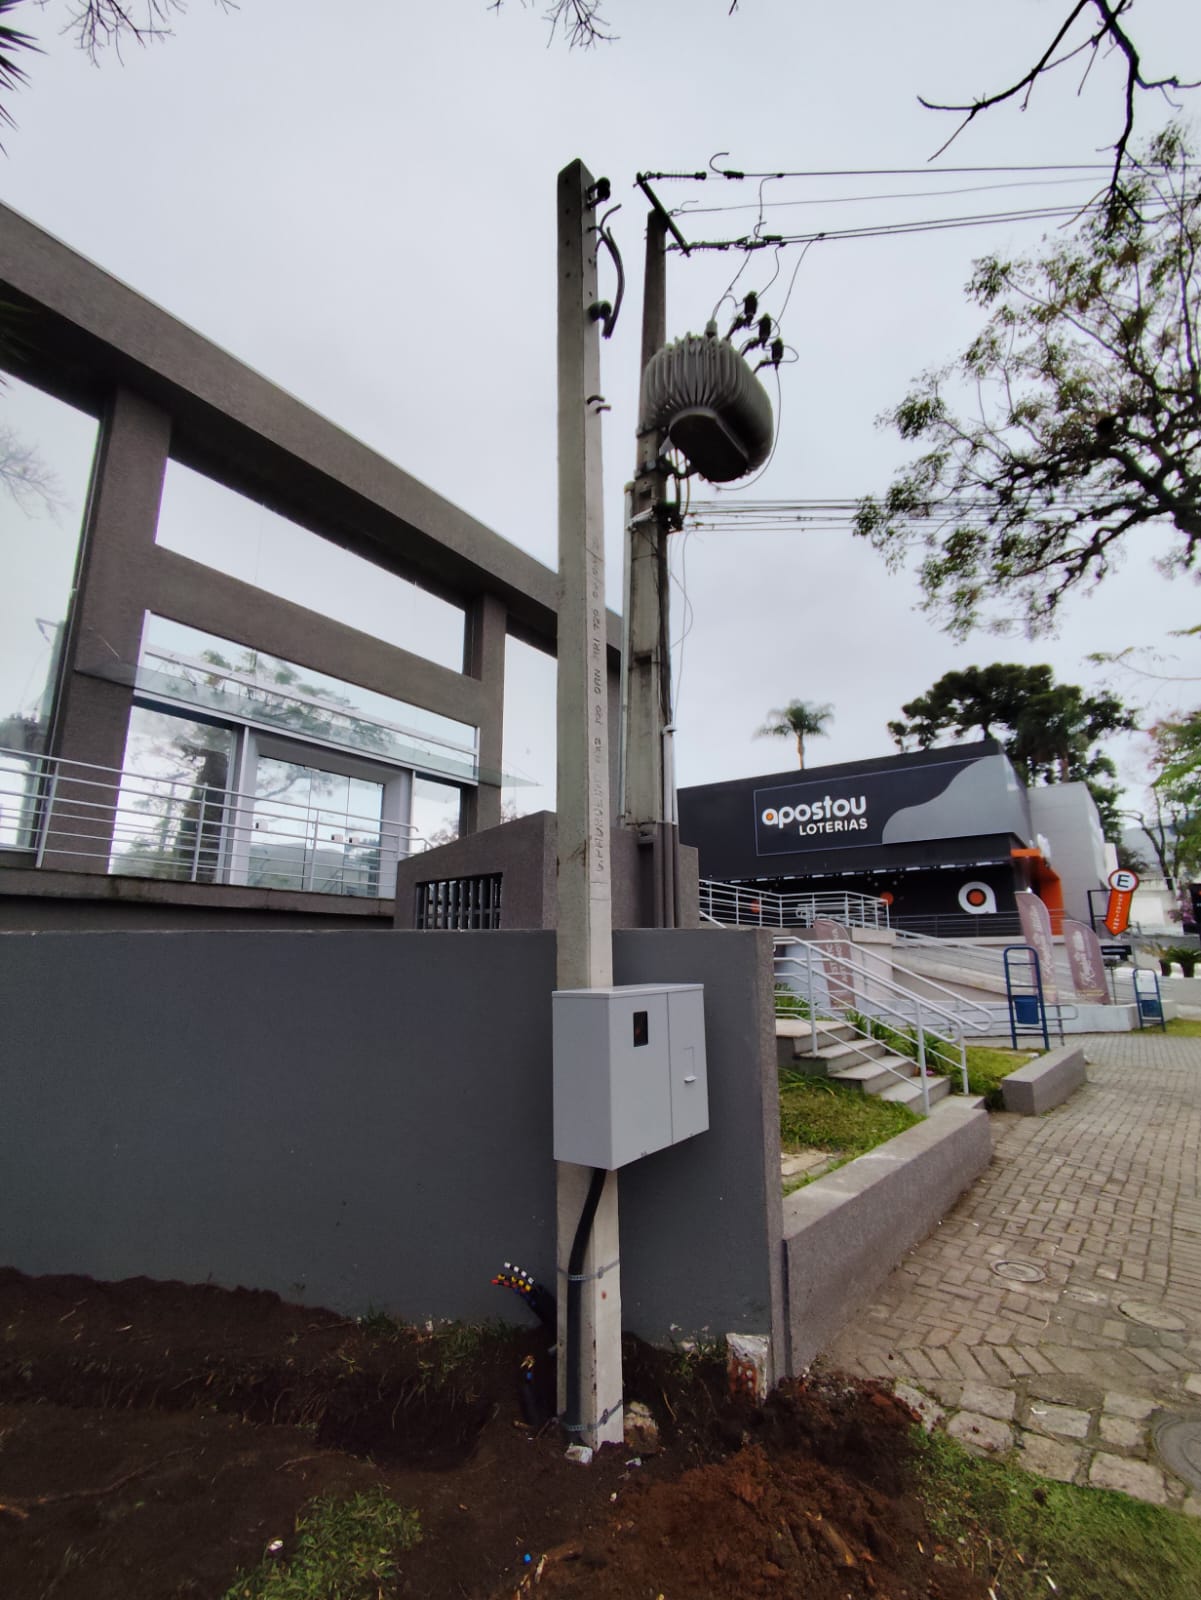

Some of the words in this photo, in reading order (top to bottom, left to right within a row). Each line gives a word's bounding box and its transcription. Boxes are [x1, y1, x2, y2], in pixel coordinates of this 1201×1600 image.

[762, 795, 866, 829] apostou
[799, 818, 868, 836] LOTERIAS
[1116, 874, 1131, 889] E
